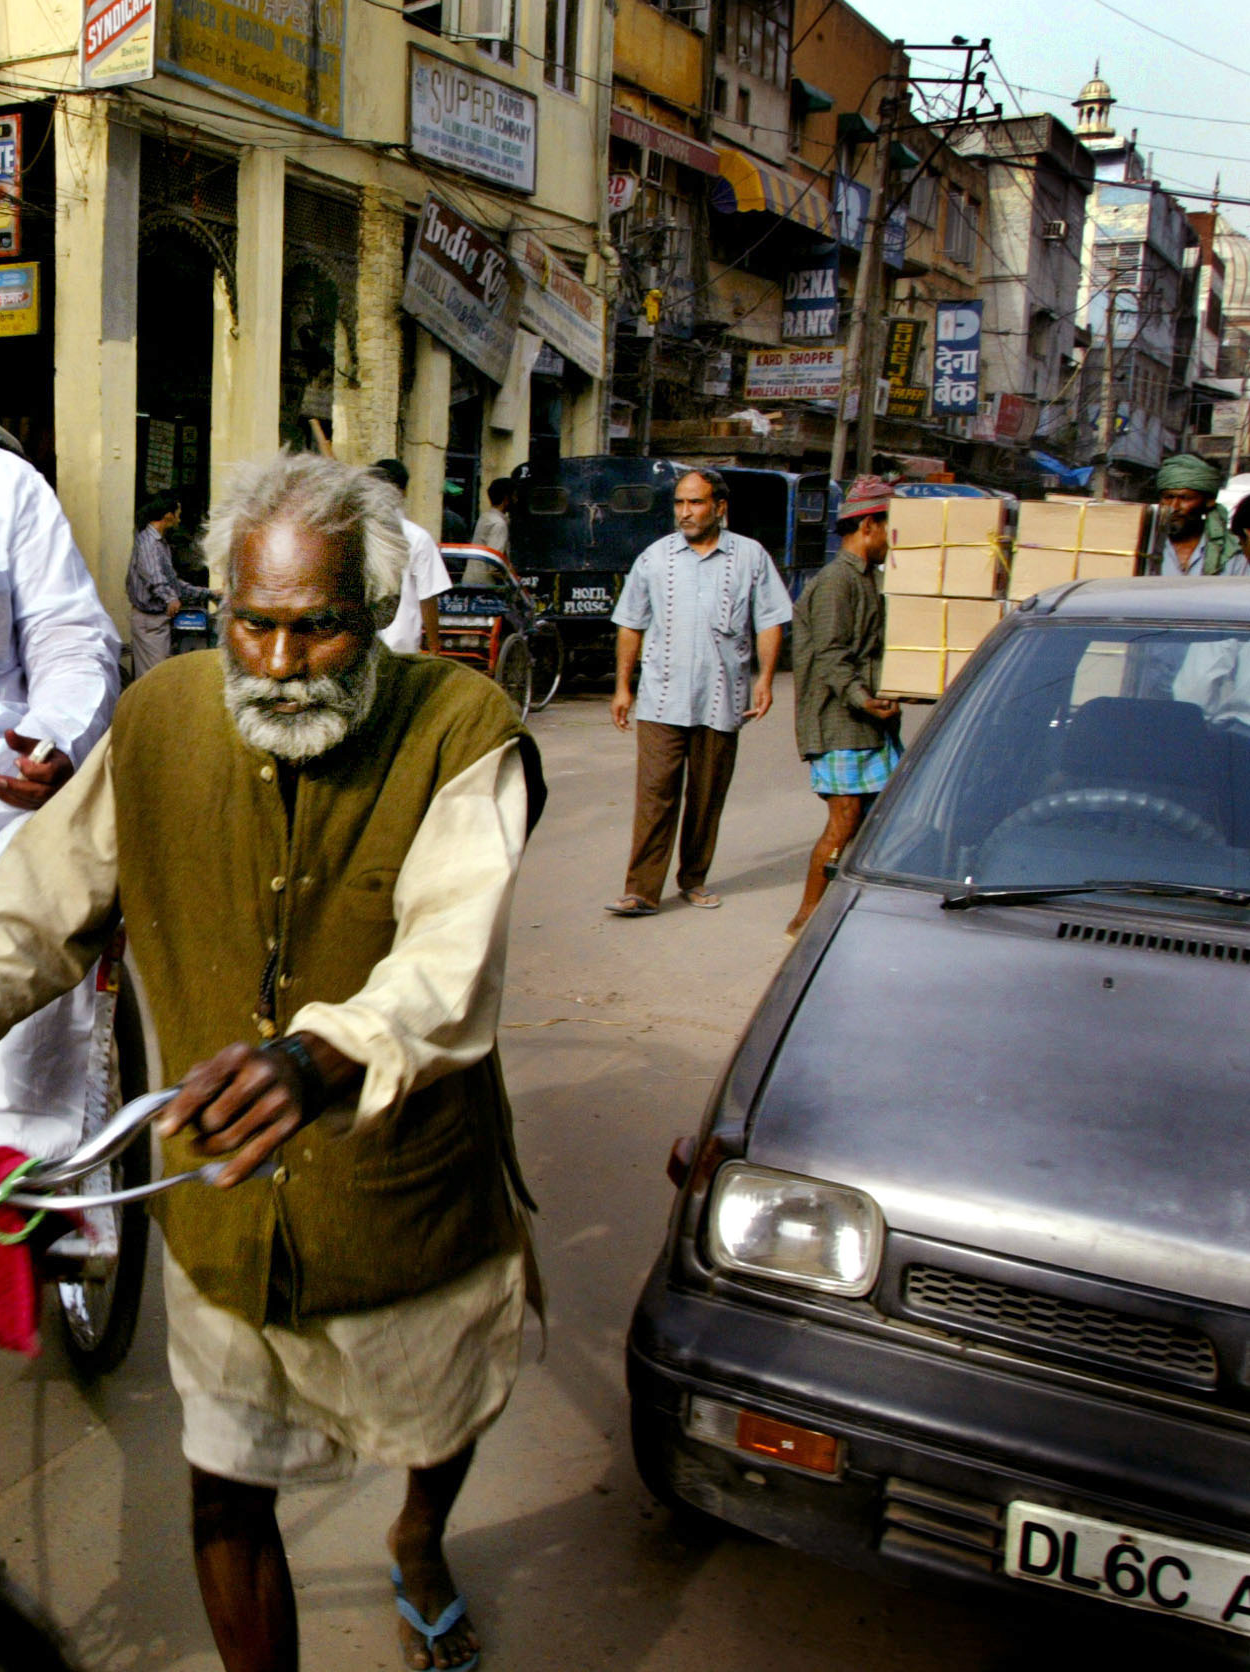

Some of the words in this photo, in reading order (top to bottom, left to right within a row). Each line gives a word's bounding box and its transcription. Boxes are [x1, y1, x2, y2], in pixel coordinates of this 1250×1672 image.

[88, 0, 151, 54] SYNDICA
[430, 69, 495, 129] SUPER
[498, 93, 525, 121] PAPER
[494, 114, 531, 144] COMPANY
[425, 202, 479, 275] India
[785, 268, 836, 300] DENA
[782, 308, 835, 338] BANK
[756, 353, 783, 367] KARD
[788, 351, 834, 365] SHOPPE
[935, 346, 978, 374] देना
[1018, 1520, 1192, 1610] DL6C
